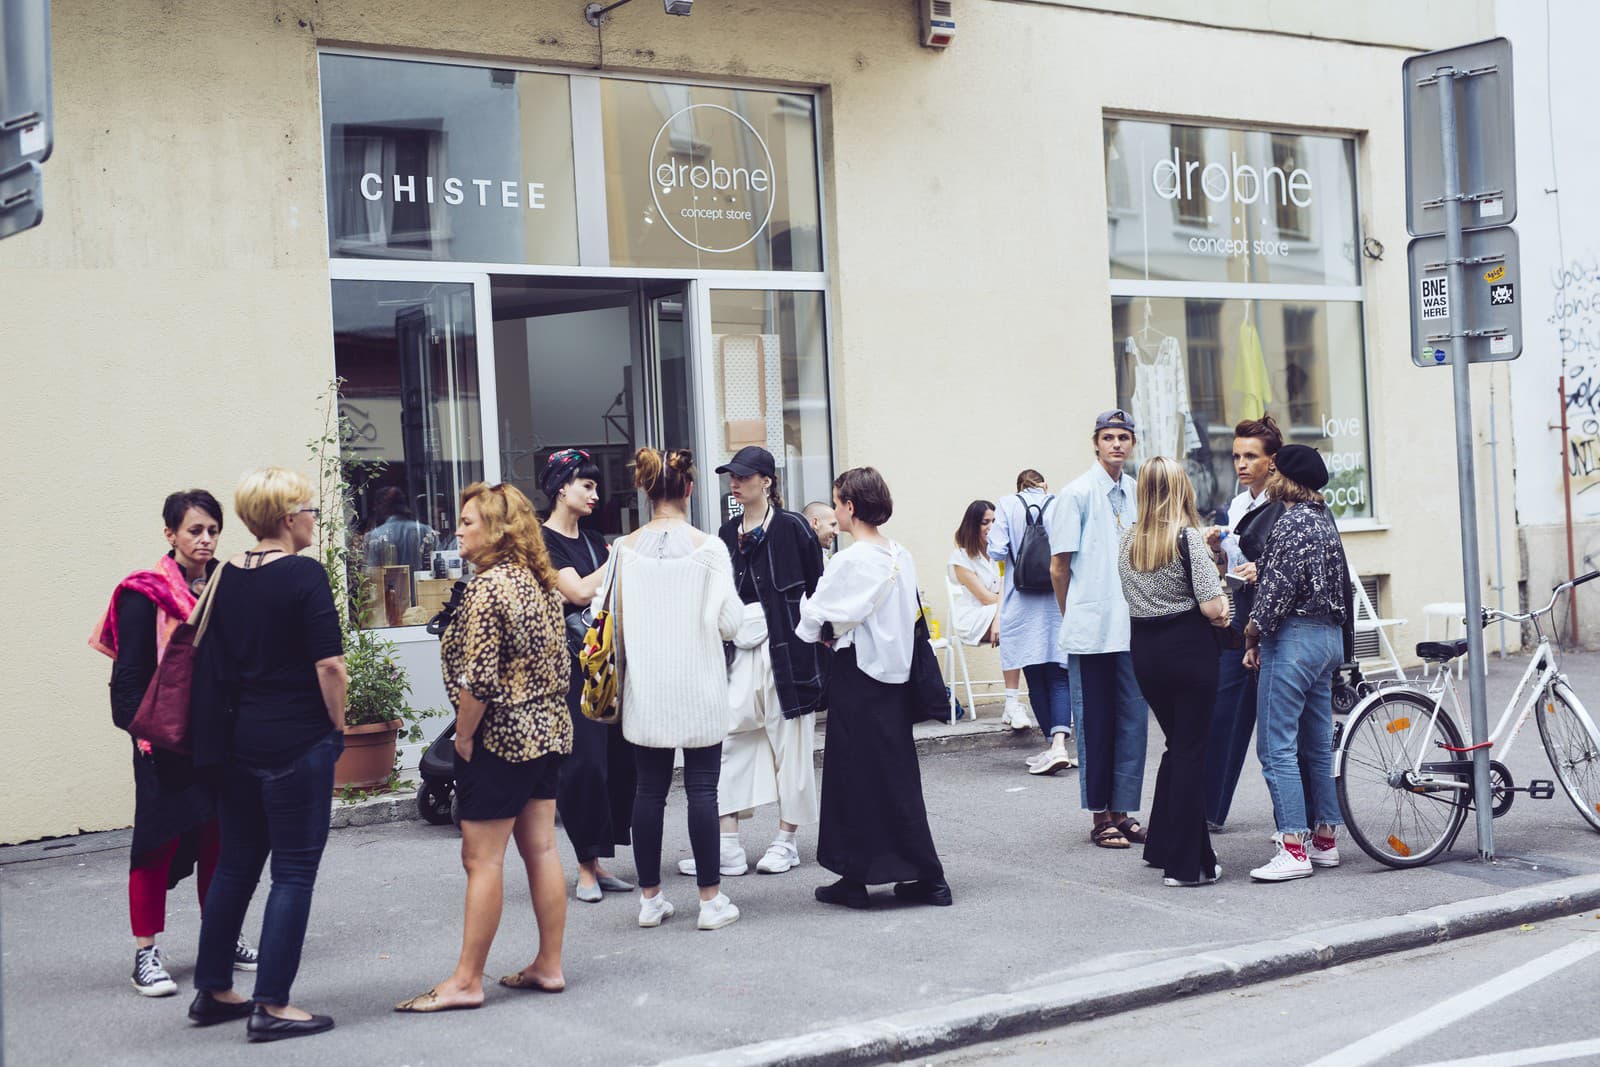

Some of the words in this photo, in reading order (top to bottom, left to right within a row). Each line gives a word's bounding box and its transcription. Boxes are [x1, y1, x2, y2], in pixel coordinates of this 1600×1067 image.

[656, 156, 769, 192] drobne
[1152, 146, 1313, 208] drobne
[360, 172, 546, 209] CHISTEE
[680, 208, 723, 221] concept
[726, 209, 752, 220] store
[1188, 237, 1249, 257] concept
[1253, 240, 1289, 257] store
[1422, 278, 1447, 297] BNE
[1423, 296, 1447, 308] WAS
[1423, 307, 1448, 318] HERE
[1321, 412, 1361, 438] love
[1317, 479, 1365, 508] ocal
